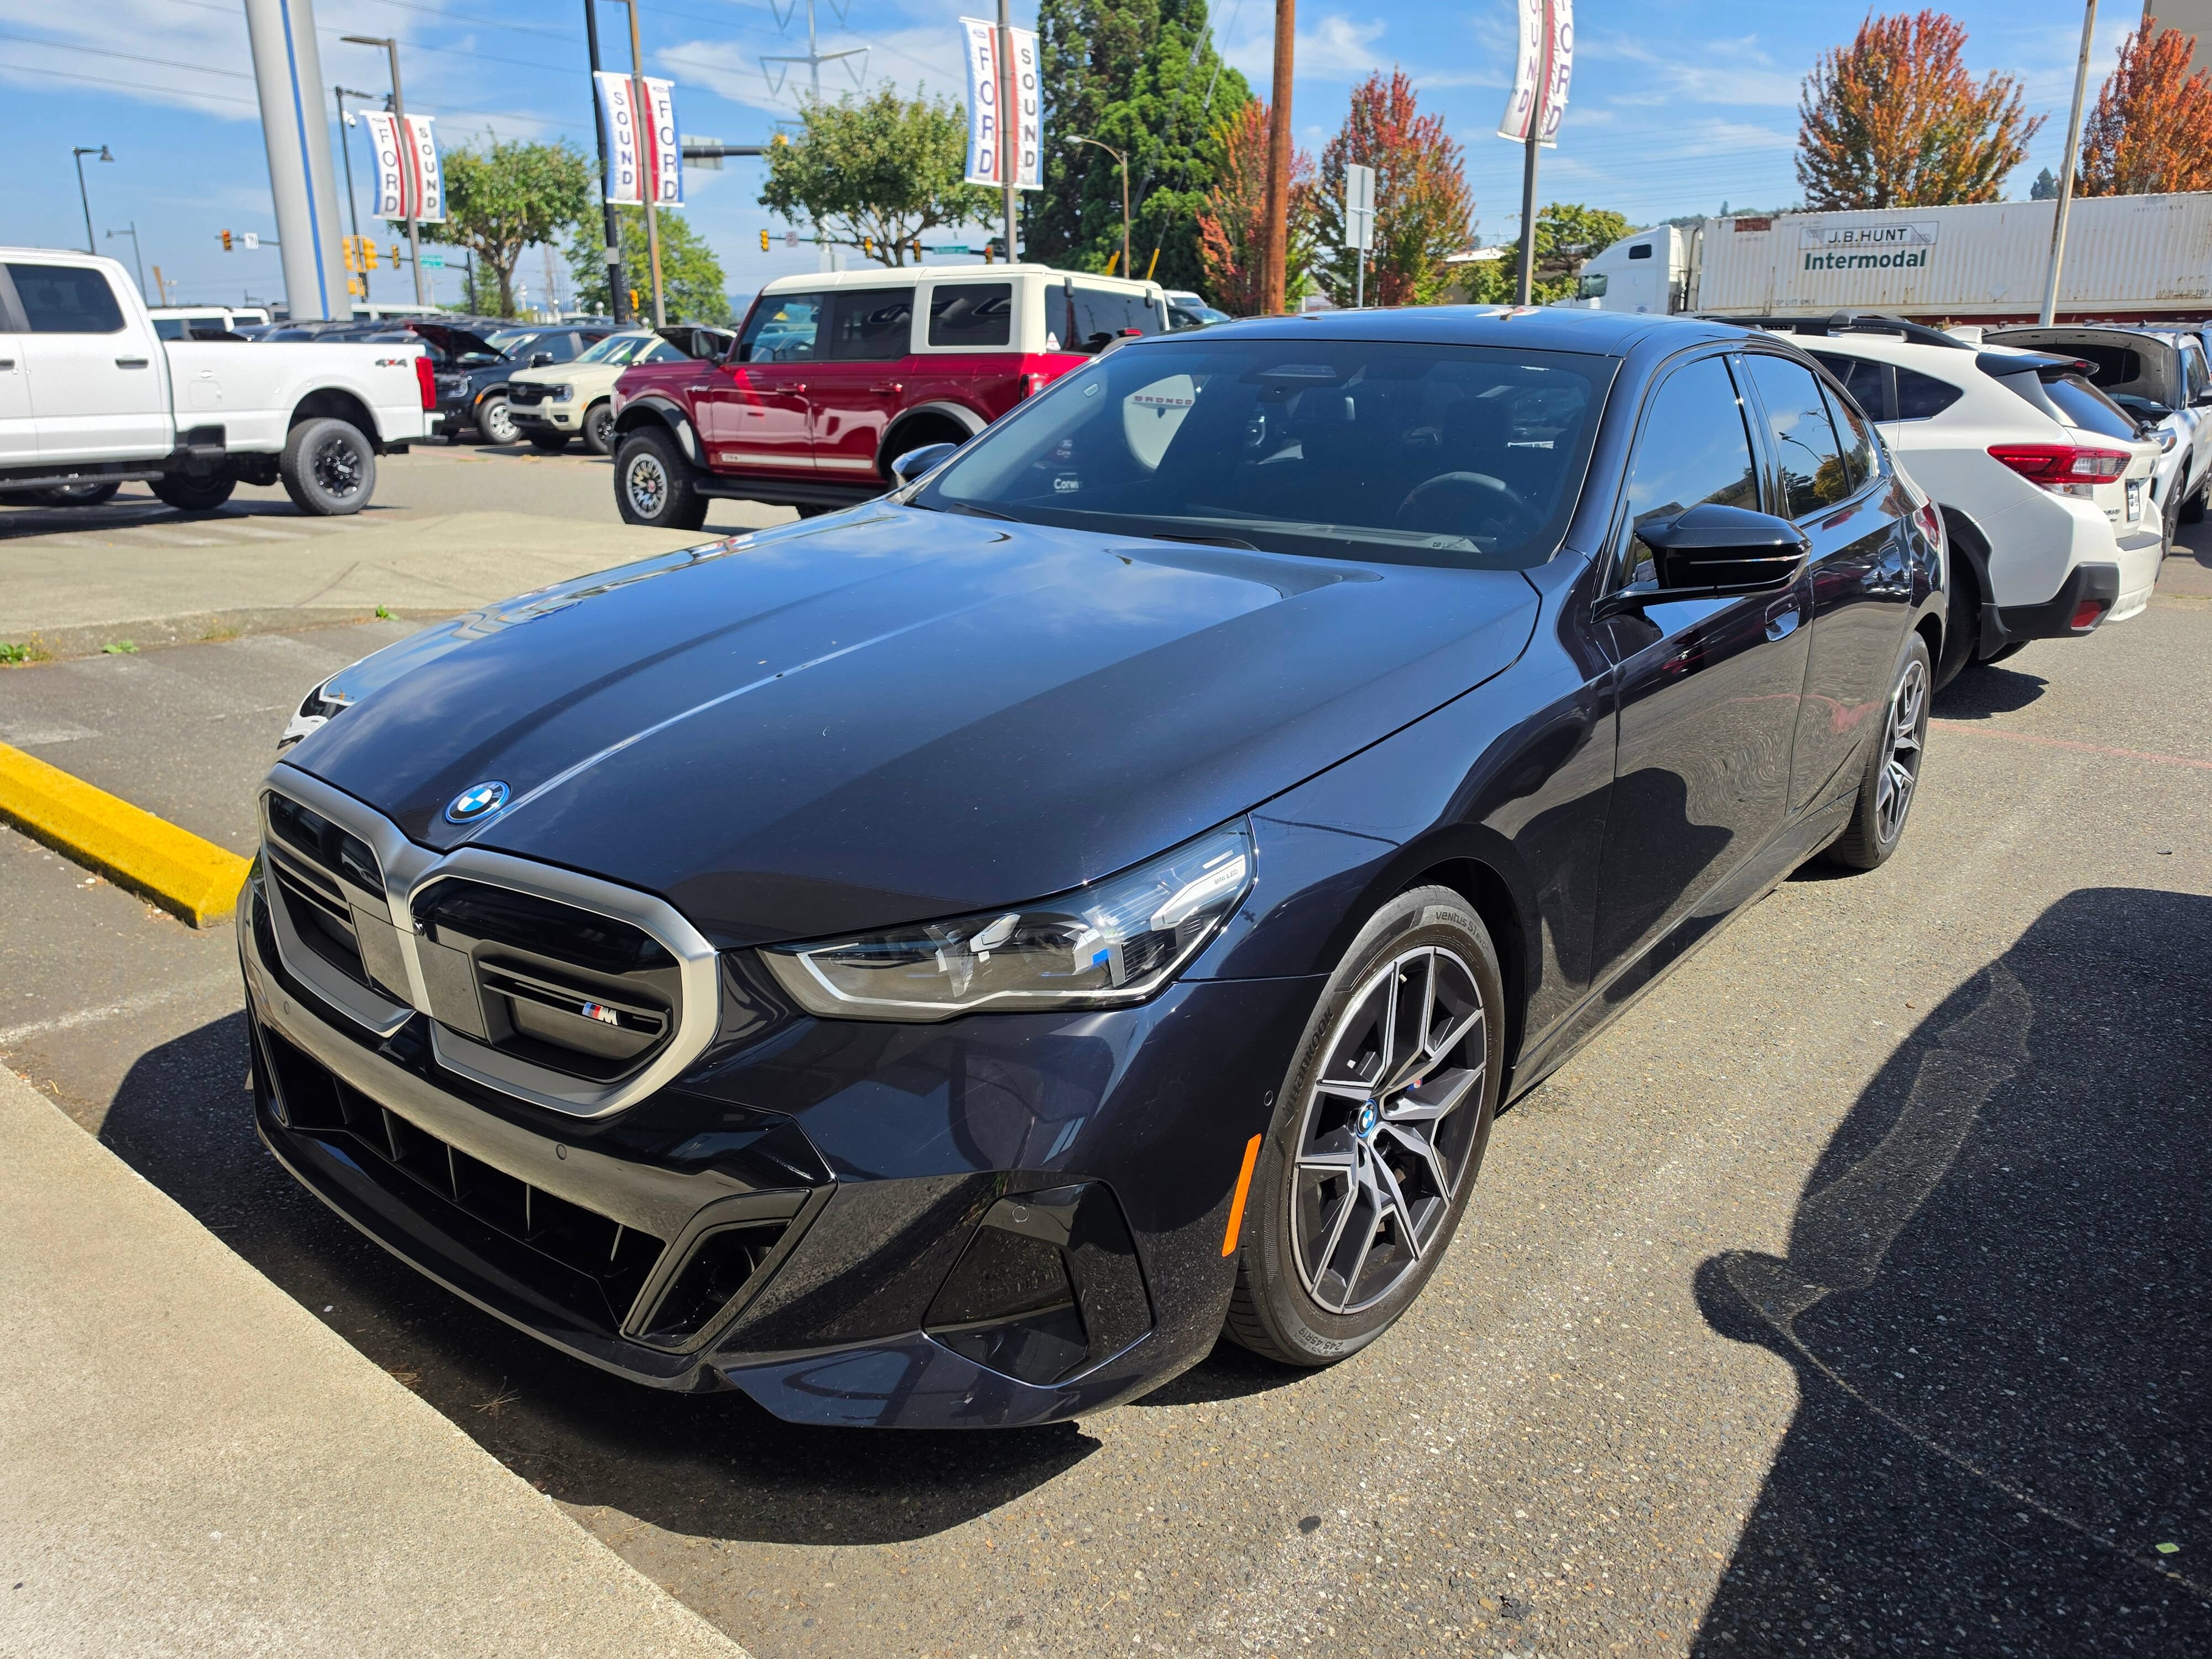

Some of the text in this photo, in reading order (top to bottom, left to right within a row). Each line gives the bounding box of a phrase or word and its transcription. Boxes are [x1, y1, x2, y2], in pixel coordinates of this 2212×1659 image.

[1517, 0, 1538, 113] OUND
[613, 92, 633, 185] SOUND
[658, 100, 677, 200] FORD
[979, 46, 995, 174] FORD
[1021, 48, 1036, 168] SOUND
[378, 127, 398, 212] FORD
[419, 127, 437, 208] SOUND
[1804, 249, 1927, 270] Intermodal
[1134, 395, 1193, 405] BRONCO
[1226, 869, 1238, 879] LED
